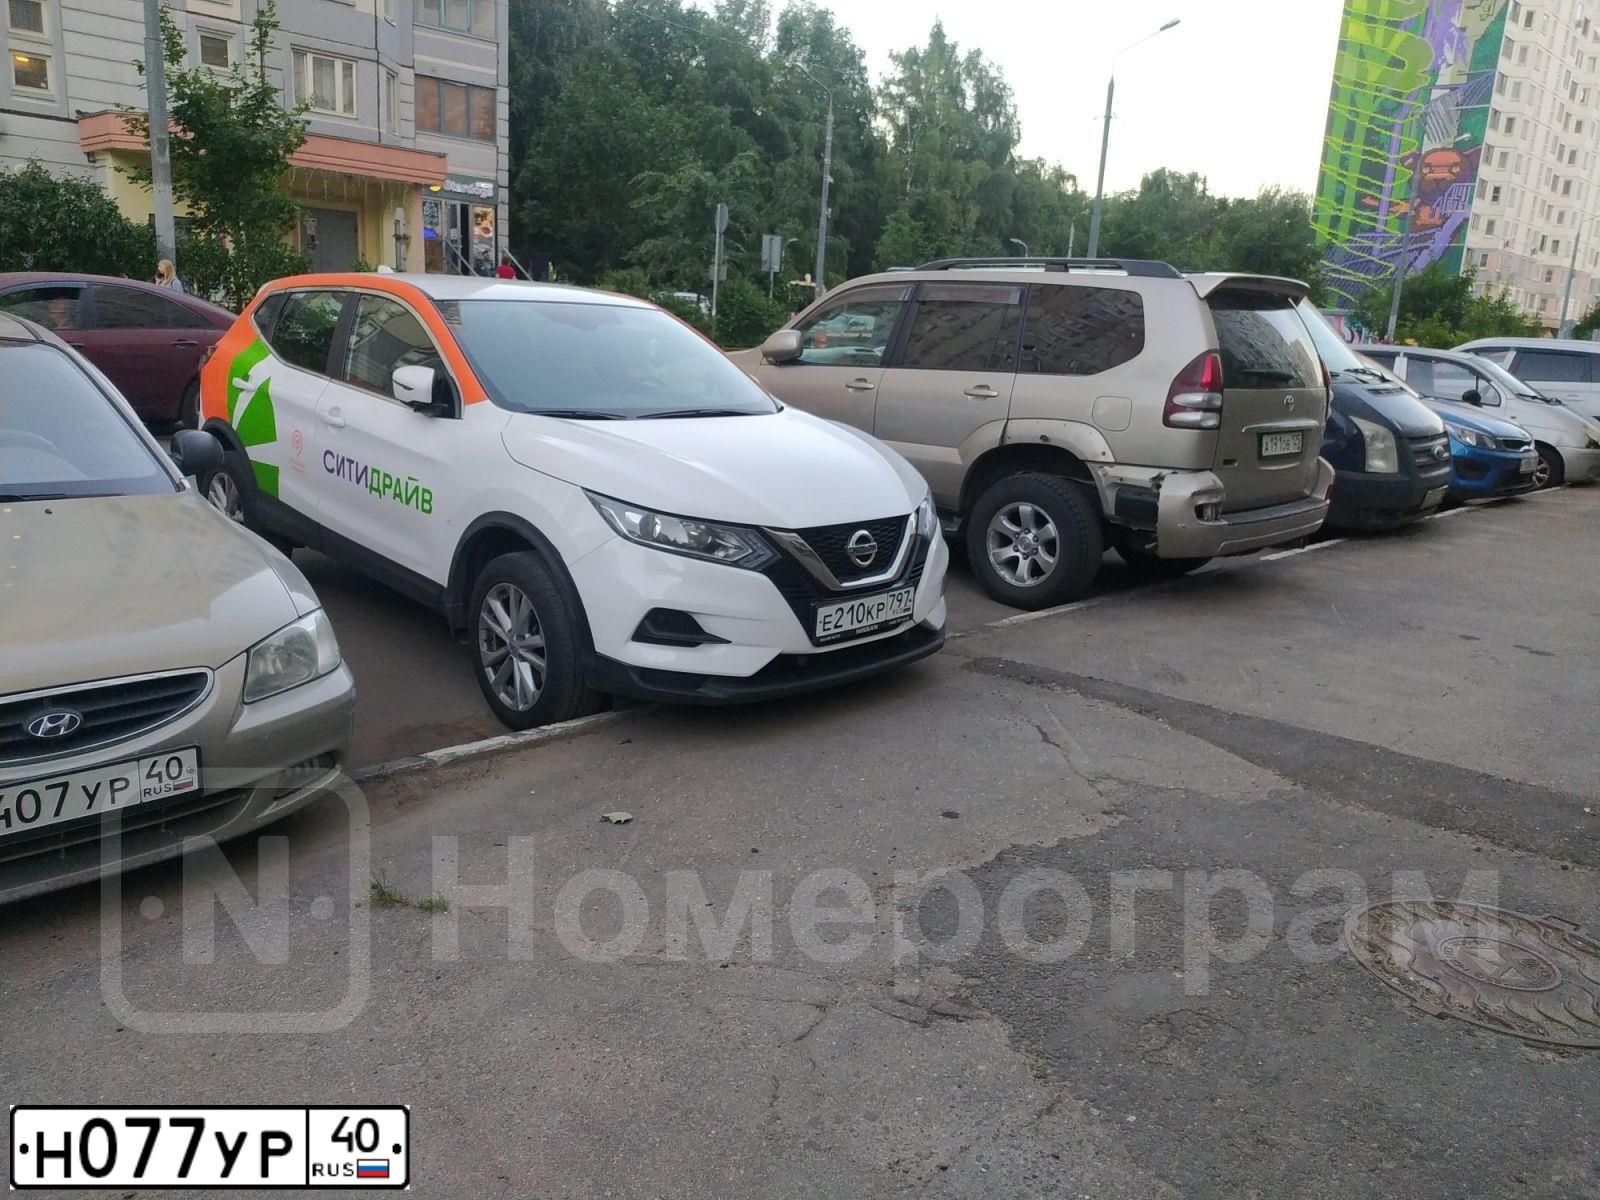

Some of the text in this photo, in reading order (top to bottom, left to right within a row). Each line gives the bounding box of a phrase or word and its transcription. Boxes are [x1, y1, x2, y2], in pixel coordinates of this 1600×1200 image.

[323, 449, 433, 515] СИТИДРАЙВ
[889, 590, 911, 611] 797
[145, 755, 183, 784] 40
[143, 783, 172, 798] RUS
